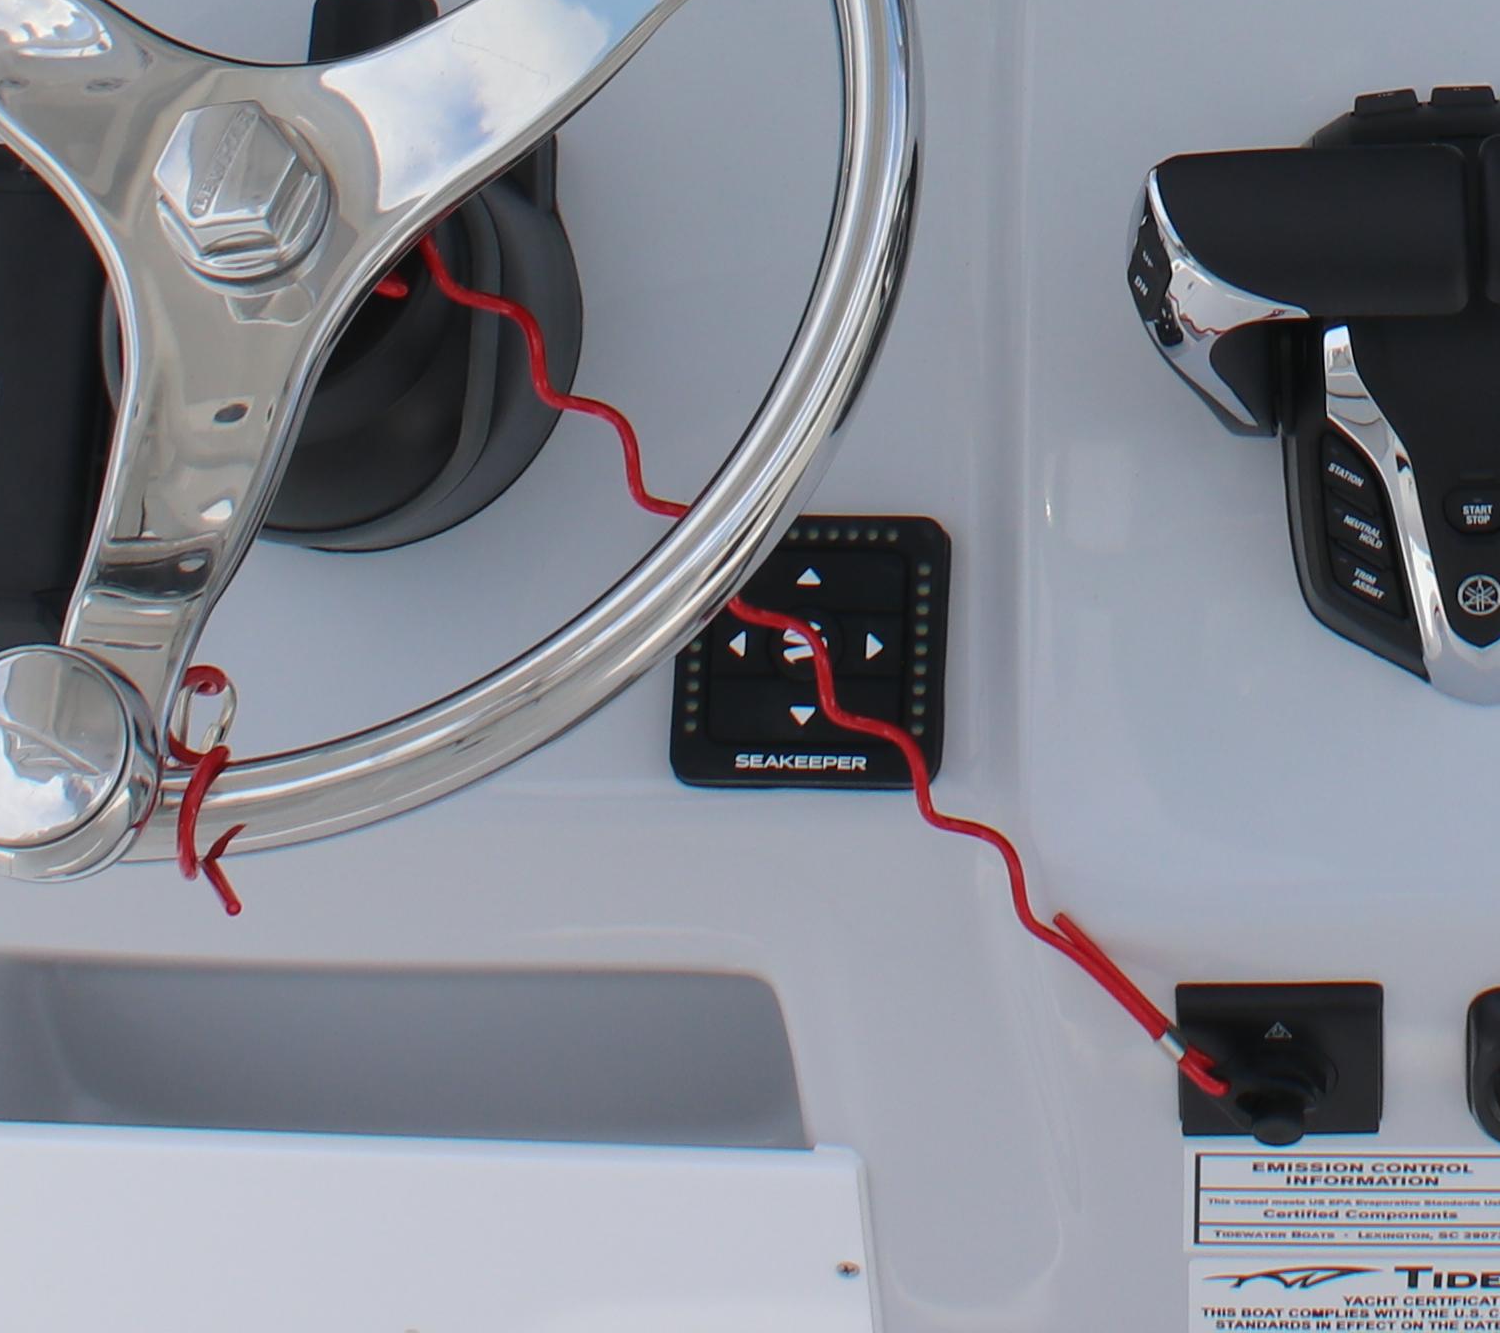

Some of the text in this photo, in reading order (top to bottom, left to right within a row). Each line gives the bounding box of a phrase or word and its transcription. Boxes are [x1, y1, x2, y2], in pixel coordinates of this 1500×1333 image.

[1327, 462, 1365, 488] STATION
[1462, 504, 1493, 515] START
[1465, 515, 1491, 525] STOP
[1343, 514, 1381, 539] NEUTRAL
[1358, 532, 1384, 550] HOLD
[1353, 567, 1377, 584] TRIM
[1352, 579, 1385, 600] ASSIST
[734, 754, 867, 771] SEAKEEPER
[1252, 1162, 1474, 1174] EMISSION CONTROL
[1285, 1175, 1440, 1186] INFORMATION
[1208, 1197, 1231, 1206] This
[1308, 1198, 1326, 1206] US
[1328, 1198, 1352, 1206] EPA
[1355, 1198, 1421, 1208] Evaporative
[1424, 1199, 1481, 1207] Standards
[1263, 1208, 1458, 1221] Certified Components
[1213, 1229, 1287, 1239] TIDEWATER
[1291, 1229, 1335, 1239] BOATS
[1438, 1231, 1459, 1240] SC
[1343, 1295, 1398, 1306] YACHT
[1202, 1307, 1236, 1318] THIS
[1241, 1307, 1284, 1318] BOAT
[1288, 1307, 1369, 1318] COMPLIES
[1374, 1307, 1413, 1318] WITH
[1419, 1307, 1448, 1318] THE
[1454, 1307, 1484, 1318] U.S.
[1216, 1320, 1311, 1331] STANDARDS
[1316, 1320, 1332, 1331] IN
[1336, 1320, 1397, 1331] EFFECT
[1401, 1320, 1424, 1331] ON
[1429, 1320, 1458, 1331] THE
